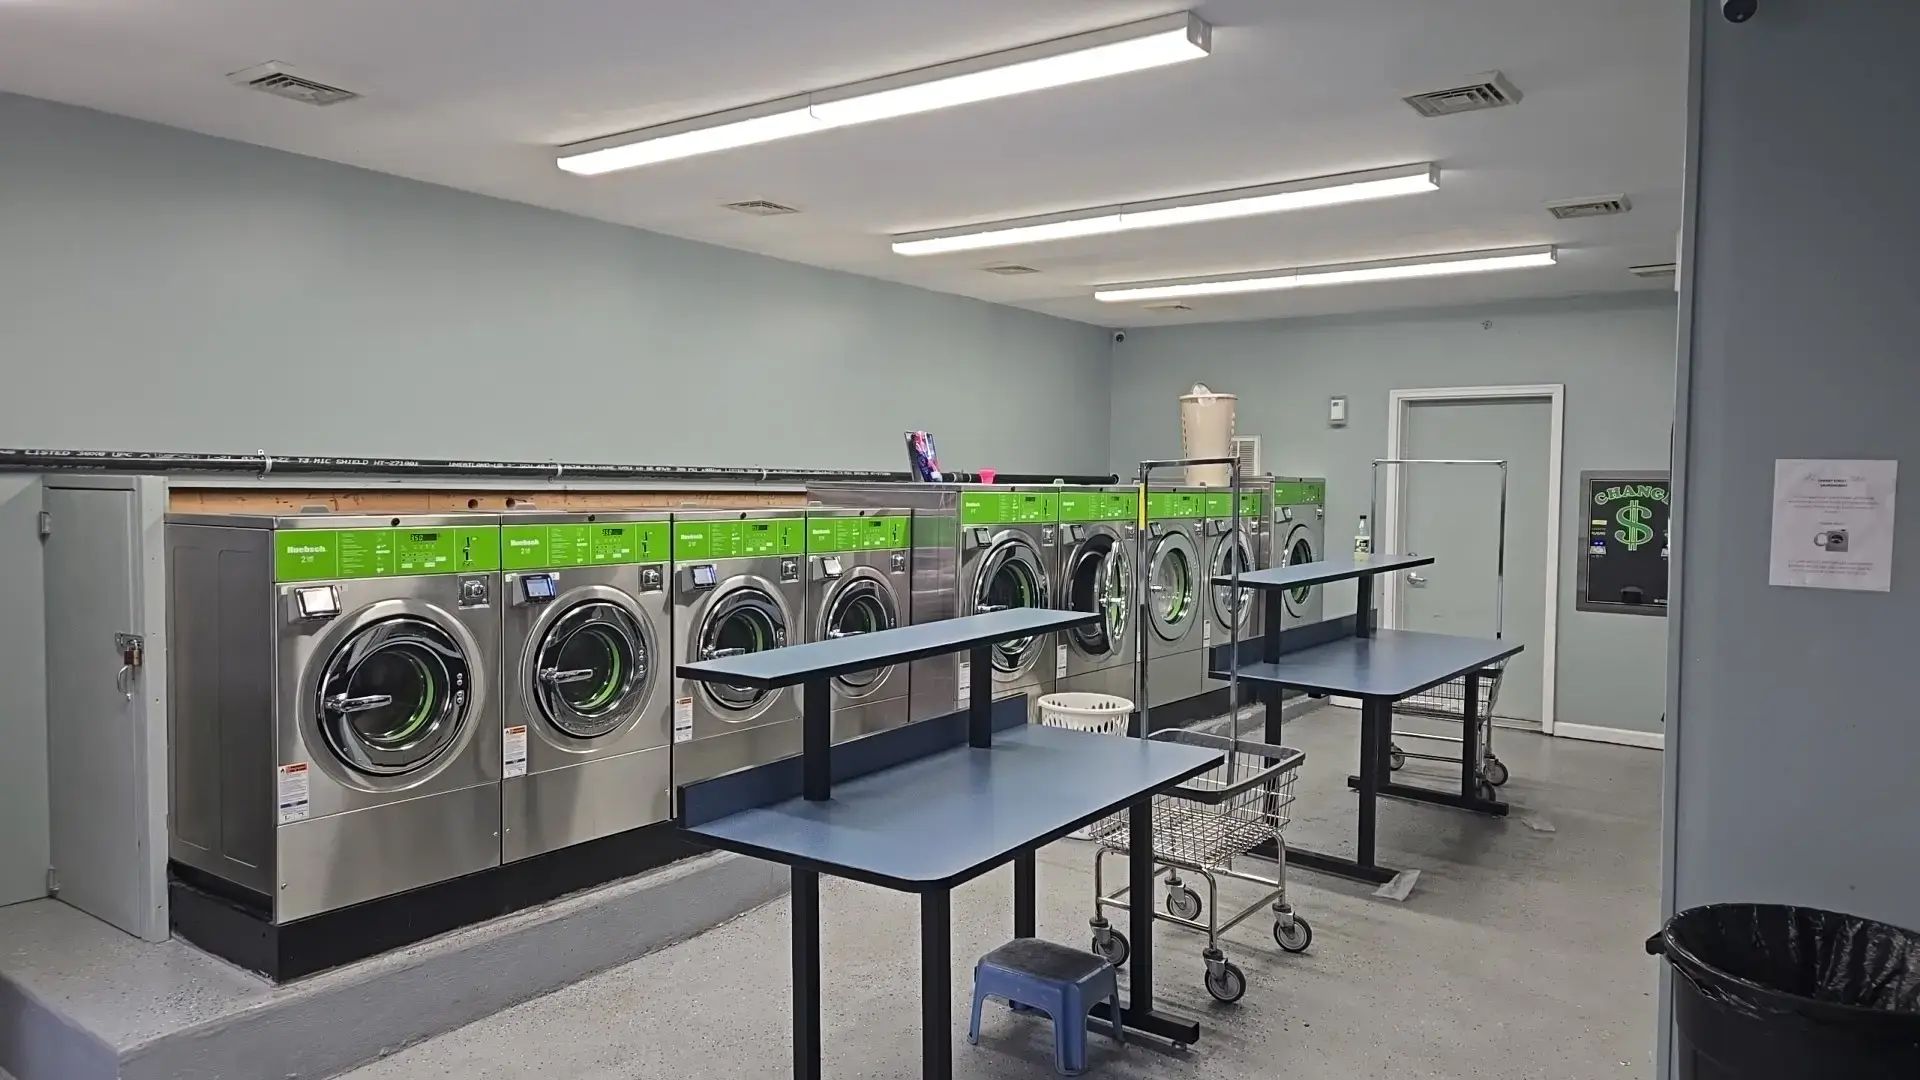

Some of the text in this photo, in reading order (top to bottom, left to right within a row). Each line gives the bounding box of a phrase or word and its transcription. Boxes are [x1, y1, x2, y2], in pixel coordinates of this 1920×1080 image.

[24, 449, 71, 457] LISTED
[335, 458, 369, 466] SHIELD
[286, 546, 327, 554] Huebsch
